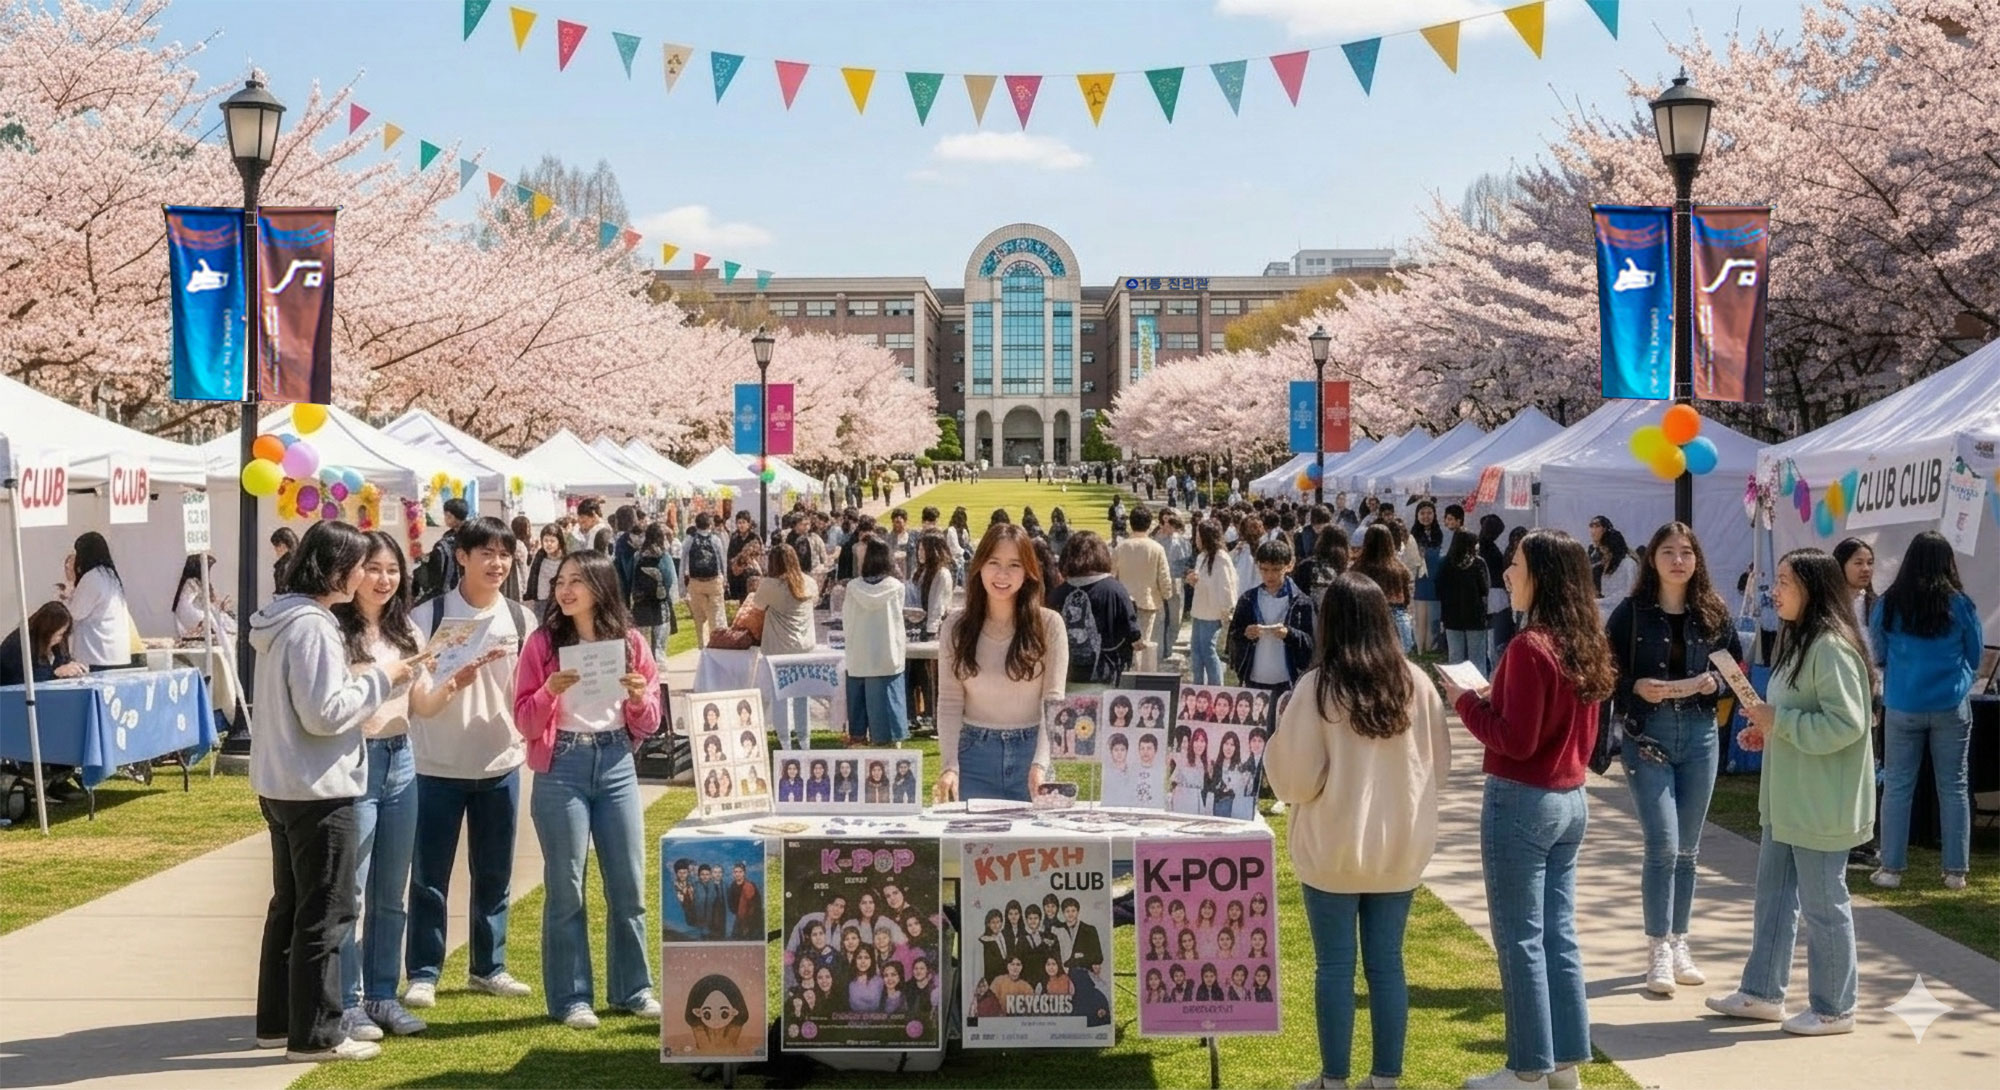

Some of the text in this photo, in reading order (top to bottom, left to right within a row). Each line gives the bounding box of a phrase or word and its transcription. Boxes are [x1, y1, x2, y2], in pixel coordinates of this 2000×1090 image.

[1167, 278, 1209, 290] 진리관
[21, 467, 65, 509] CLUB
[112, 467, 148, 506] CLUB
[1856, 459, 1942, 514] CLUB CLUB
[820, 849, 916, 875] K-POP
[974, 846, 1085, 887] KYFXH
[1143, 856, 1265, 893] K-POP
[1050, 872, 1105, 891] CLUB
